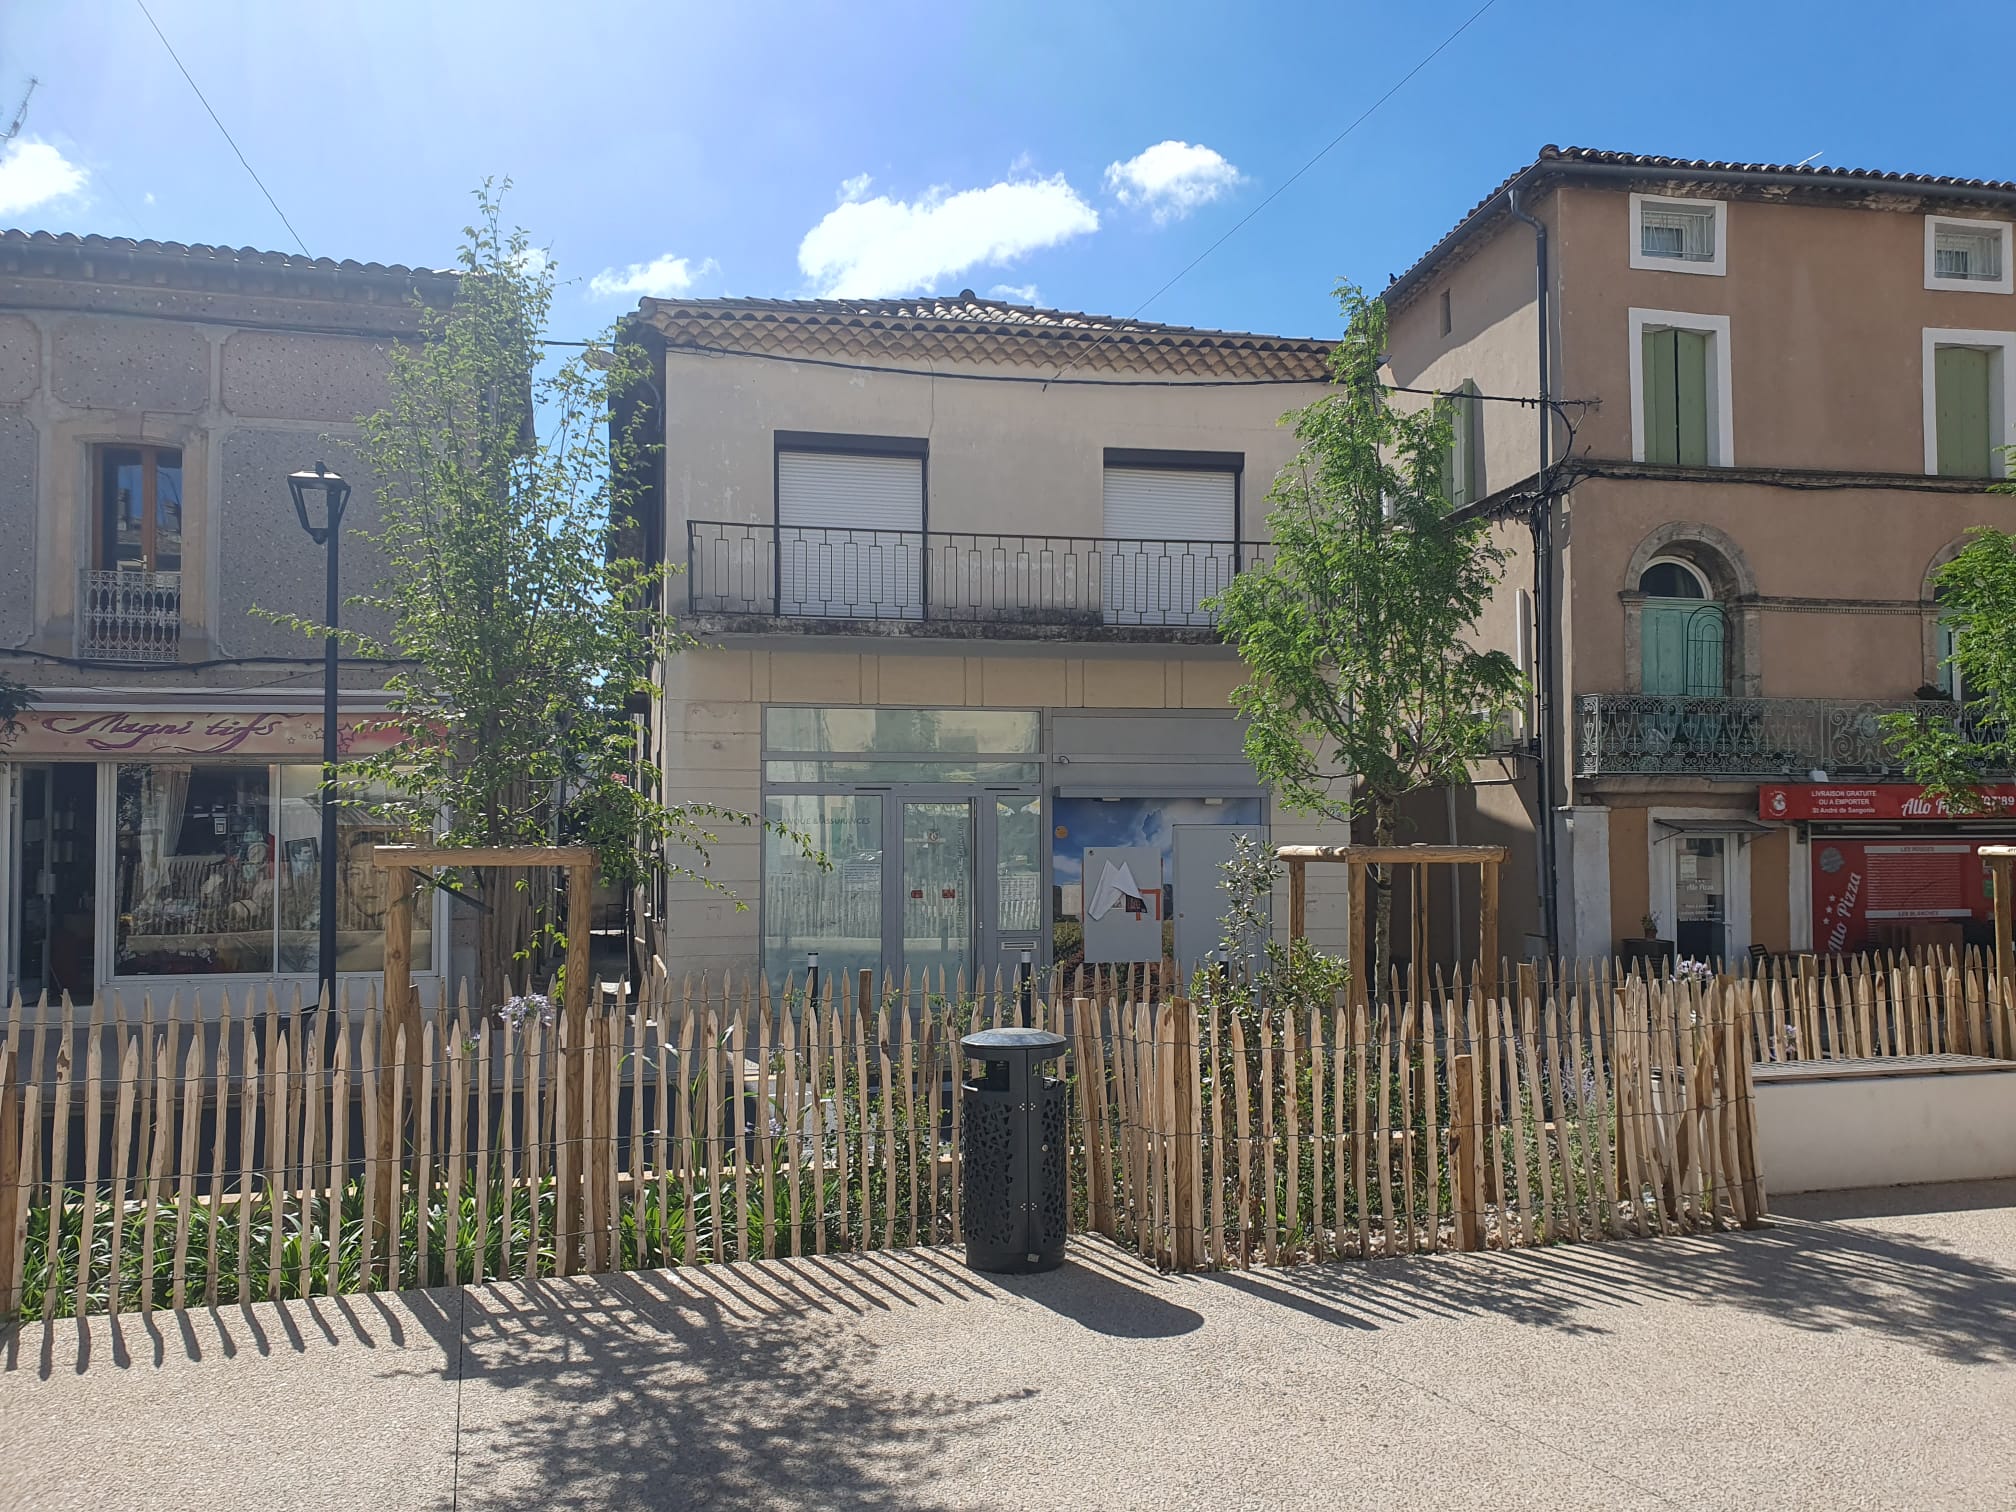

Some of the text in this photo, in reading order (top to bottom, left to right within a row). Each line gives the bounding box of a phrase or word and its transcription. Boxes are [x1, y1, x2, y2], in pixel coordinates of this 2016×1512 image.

[1901, 797, 1932, 817] Allo
[779, 817, 812, 825] ANQUE
[820, 817, 872, 825] ASSURANCES
[1836, 872, 1862, 918] Pizza
